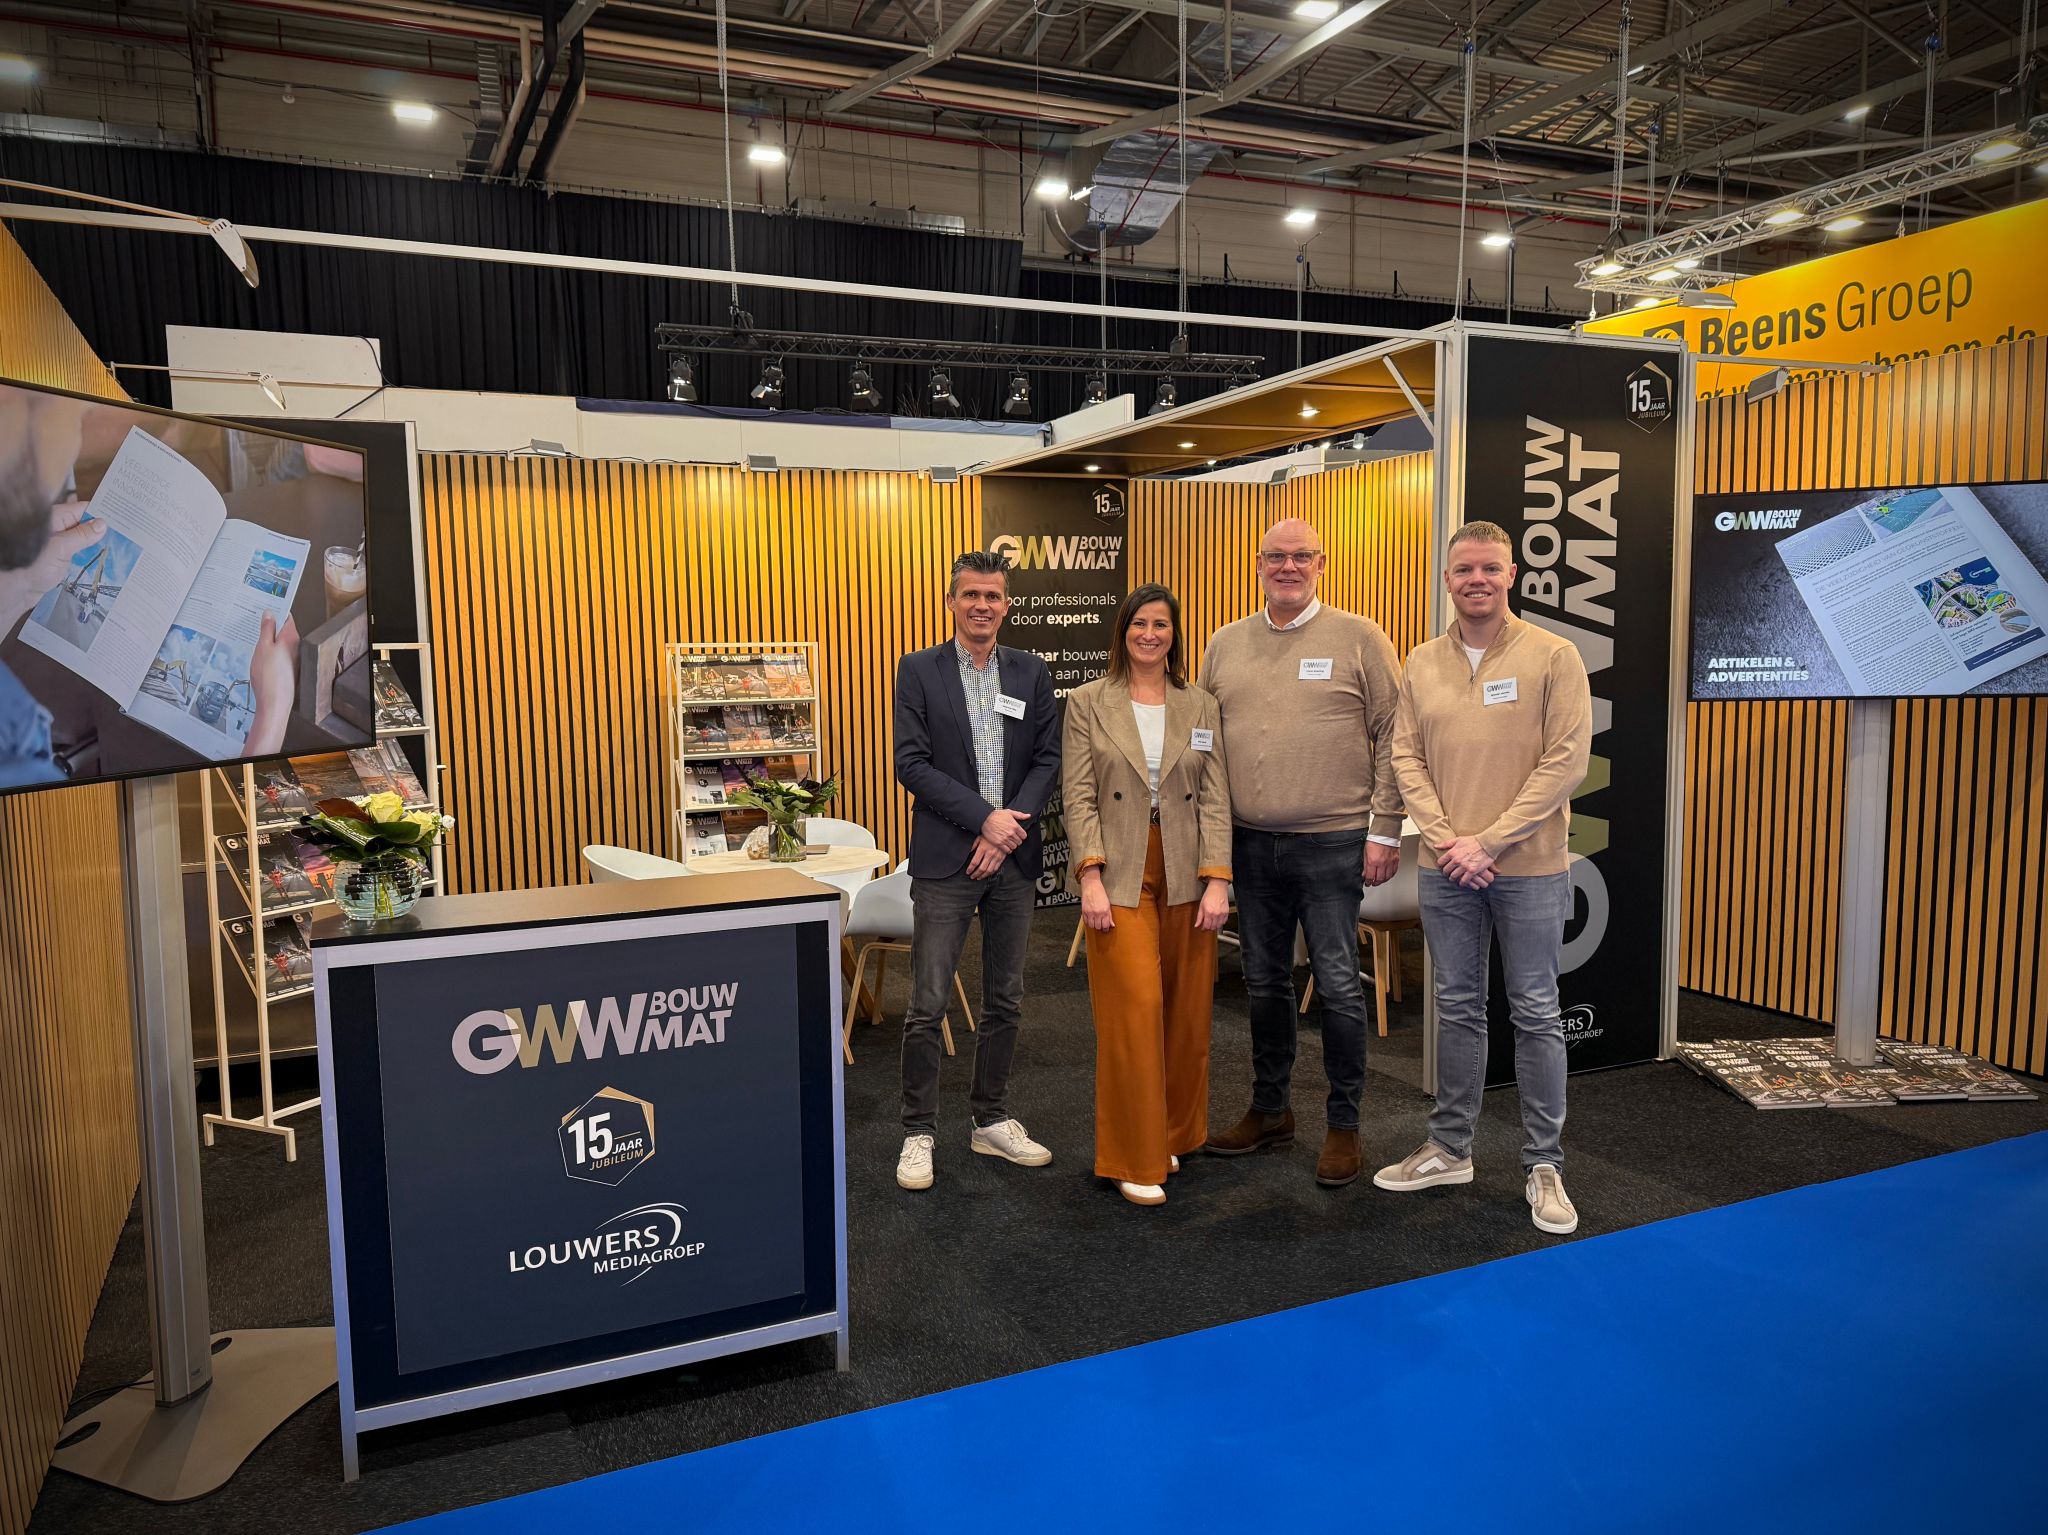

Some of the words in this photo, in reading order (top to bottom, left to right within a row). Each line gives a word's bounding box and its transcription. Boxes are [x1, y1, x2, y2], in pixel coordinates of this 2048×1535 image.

[1700, 302, 1827, 356] Beens
[1836, 267, 1973, 332] Groep
[1629, 379, 1651, 412] 15
[1650, 402, 1666, 411] JAAR
[1094, 493, 1110, 514] 15
[1521, 414, 1565, 608] BOUW
[1564, 432, 1620, 627] MAT
[1714, 510, 1771, 532] GWW
[1772, 509, 1802, 519] BOUW
[1769, 518, 1799, 530] MAT
[990, 535, 1080, 570] GWW
[1079, 535, 1123, 550] BOUW
[1074, 550, 1119, 570] MAT
[1031, 592, 1117, 610] professionals
[1011, 612, 1044, 625] door
[1046, 611, 1102, 627] experts.
[1707, 657, 1783, 669] ARTIKELEN
[1784, 656, 1796, 668] &
[1055, 670, 1080, 680] aan
[1707, 670, 1809, 683] ADVERTENTIES
[1042, 839, 1069, 855] BOUW
[1042, 848, 1070, 868] MAT
[1052, 889, 1077, 905] BOU
[452, 993, 648, 1075] GWW
[648, 982, 739, 1016] BOUW
[640, 1009, 732, 1053] MAT
[1563, 1028, 1604, 1043] DIAGROEP
[567, 1112, 613, 1164] 15
[612, 1138, 643, 1155] JAAR
[589, 1148, 644, 1171] JUBILEUM
[509, 1225, 660, 1273] LOUWERS
[593, 1242, 705, 1274] MEDIAGROEP
